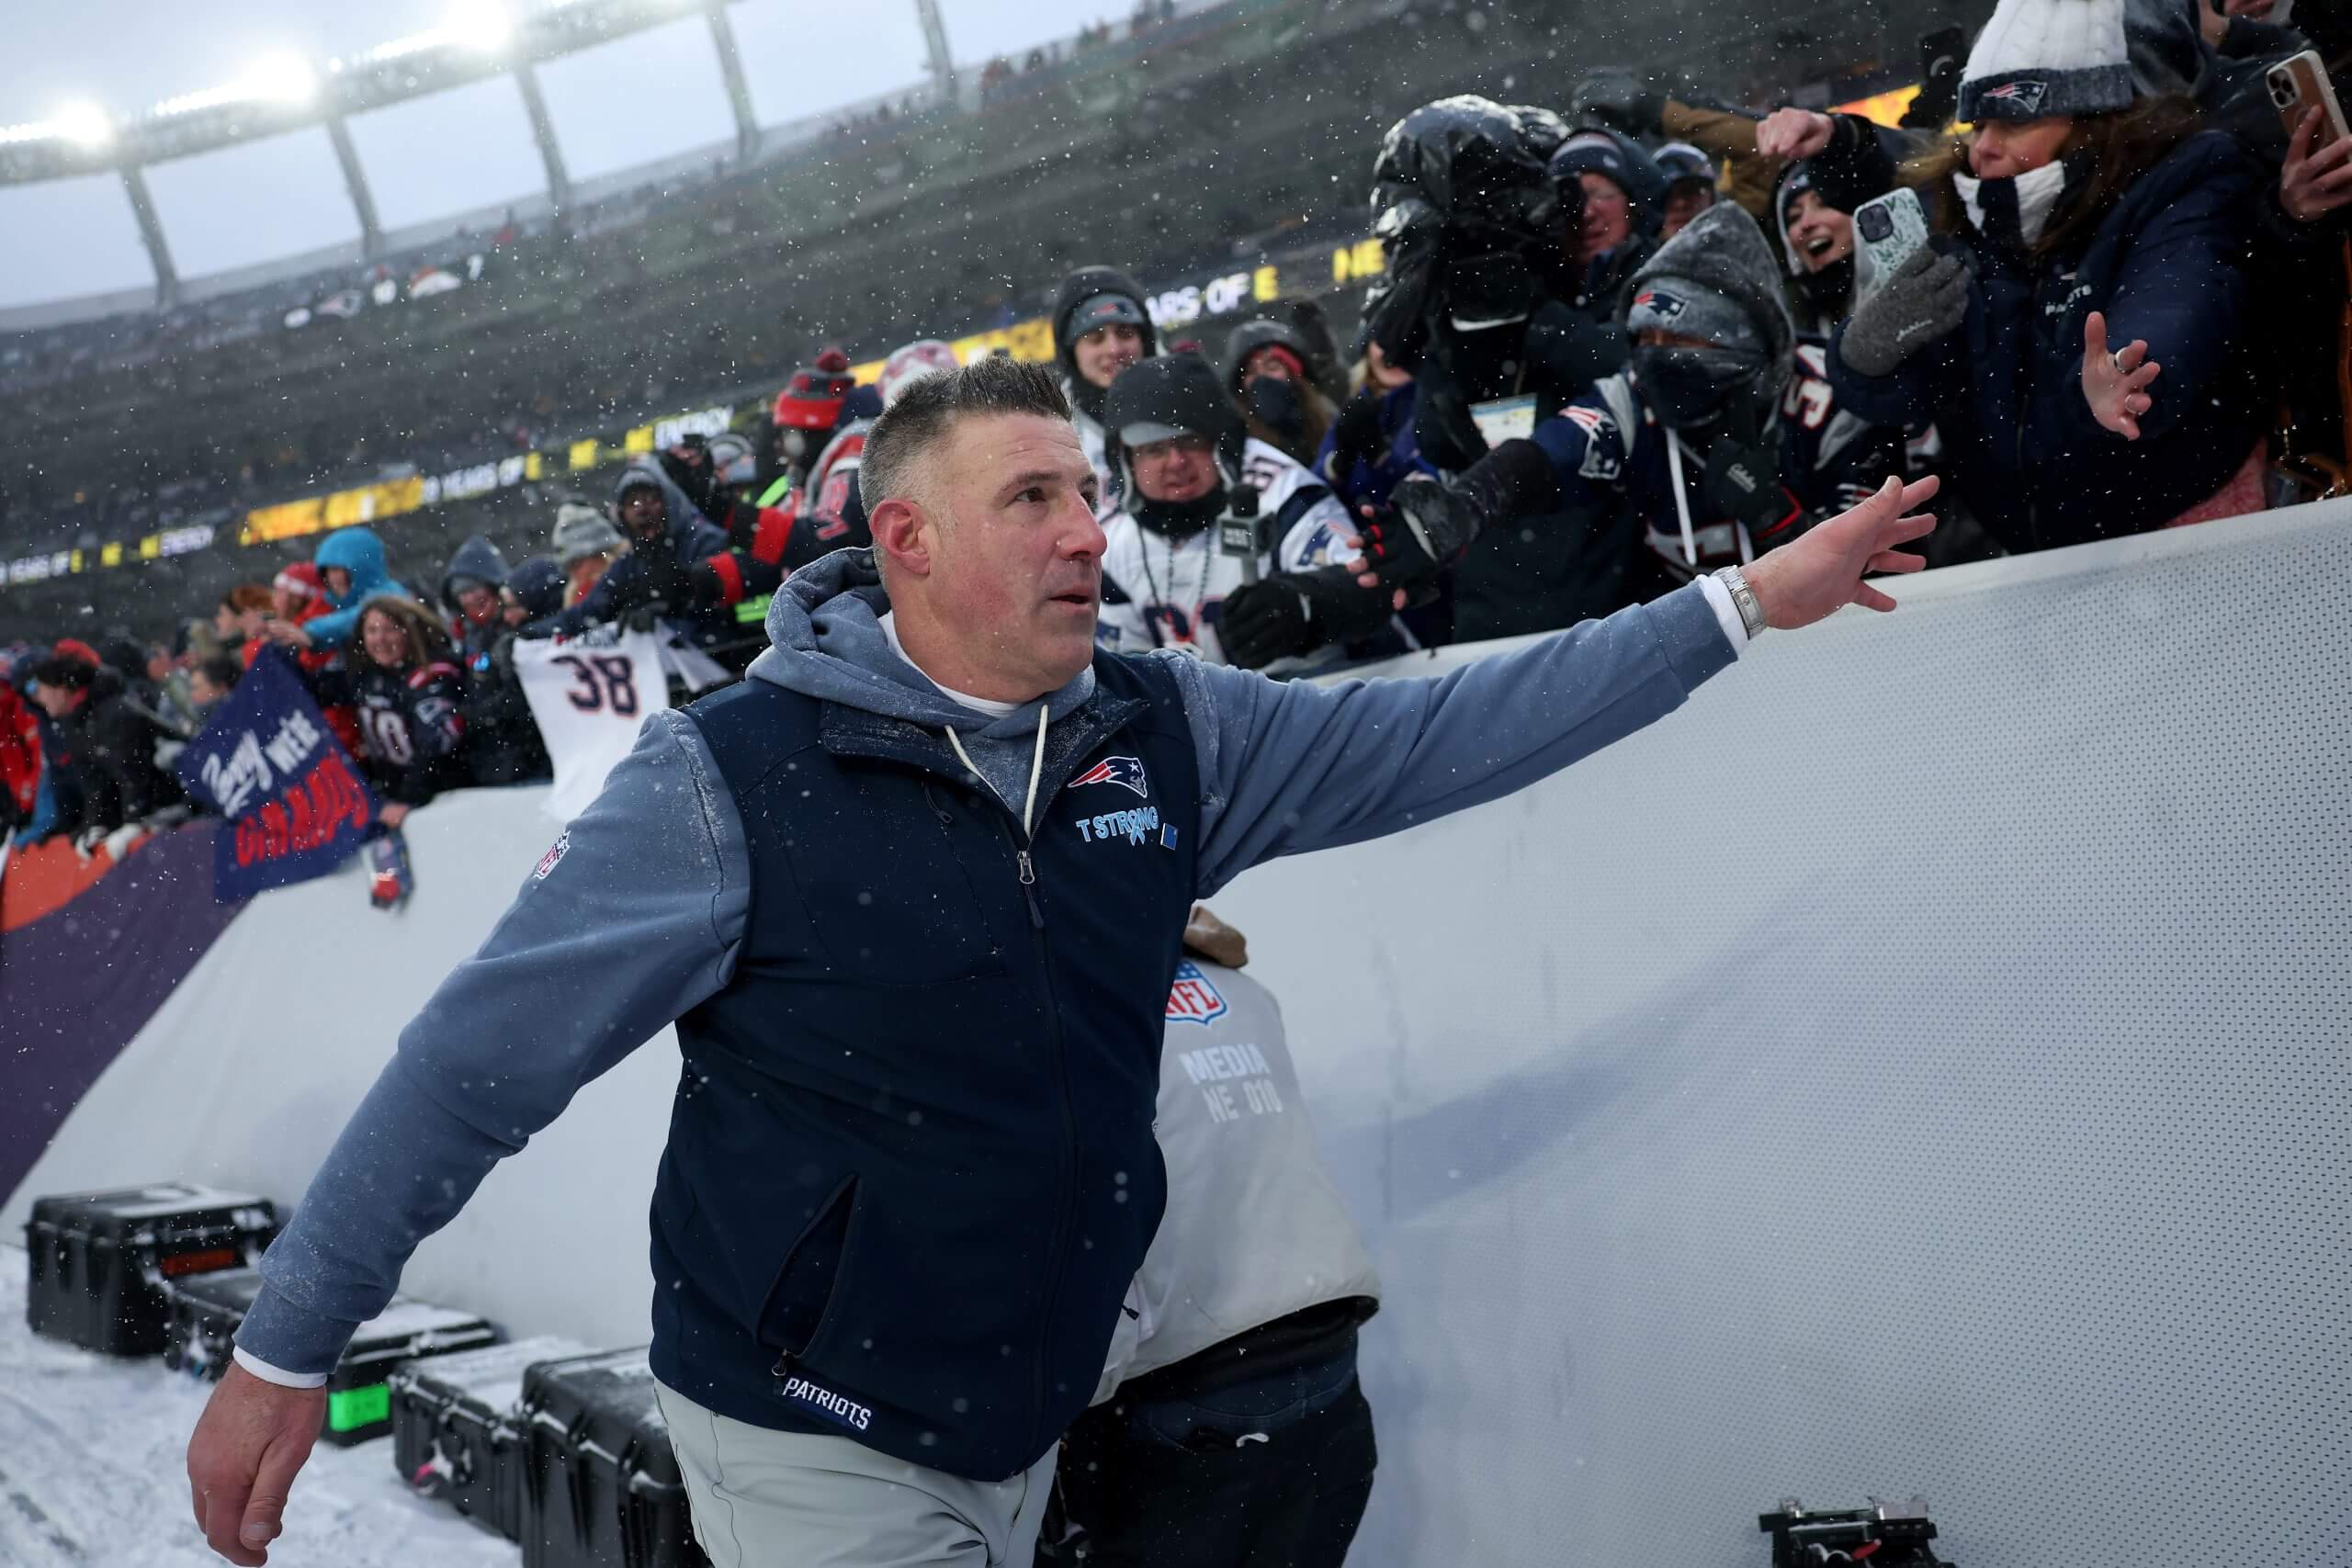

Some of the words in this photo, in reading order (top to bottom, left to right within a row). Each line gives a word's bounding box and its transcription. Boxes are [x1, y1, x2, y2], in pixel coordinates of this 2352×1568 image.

[549, 654, 640, 718] 38
[1075, 818, 1091, 842] T
[1092, 806, 1159, 844] STRONG
[1180, 1043, 1271, 1085] MEDIA
[1201, 1084, 1239, 1123] NE
[781, 1377, 872, 1430] PATRIOTS
